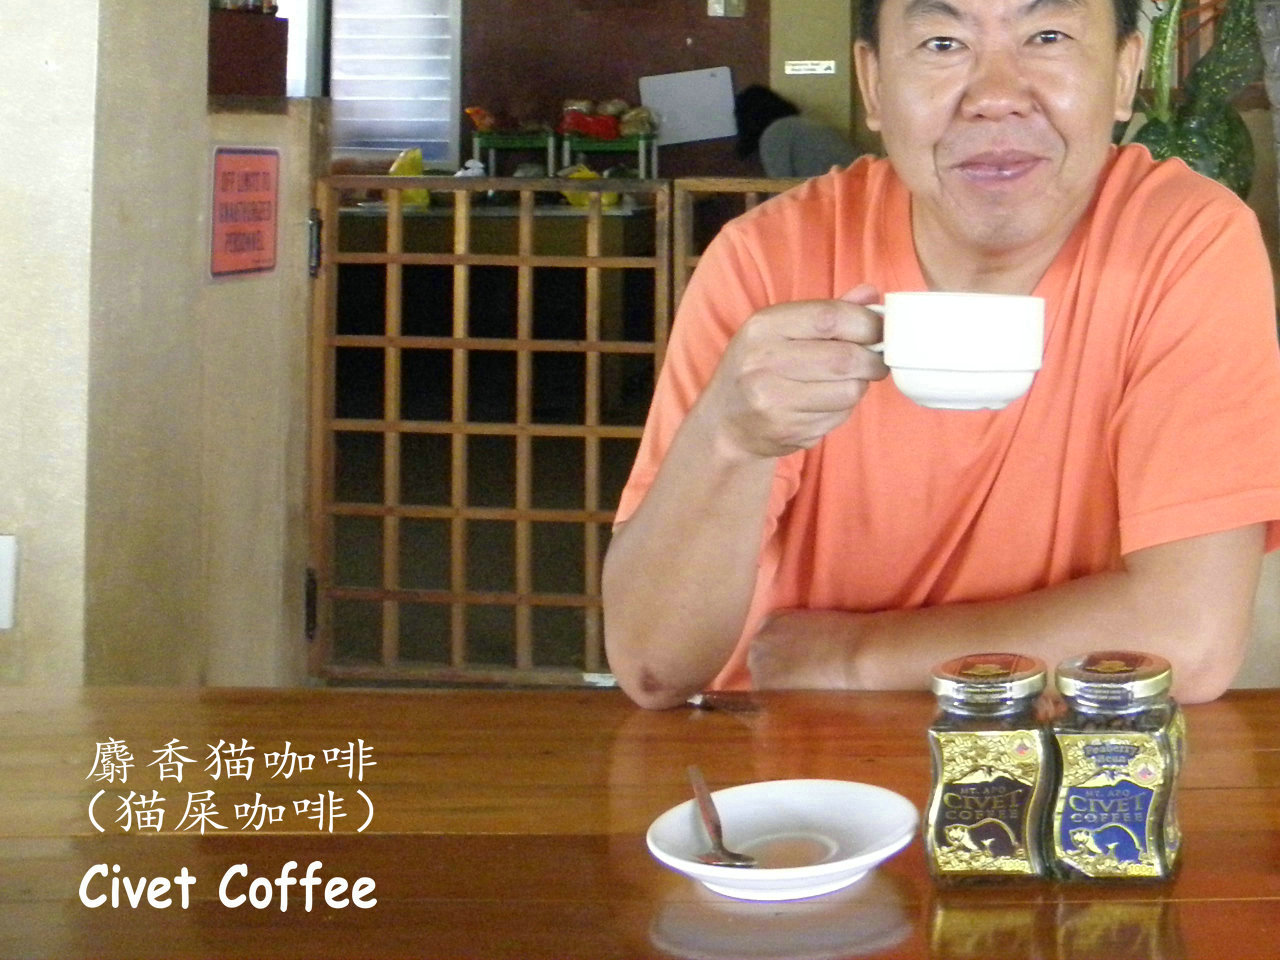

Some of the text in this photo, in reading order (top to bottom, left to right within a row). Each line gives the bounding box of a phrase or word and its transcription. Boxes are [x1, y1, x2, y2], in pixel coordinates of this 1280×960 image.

[943, 789, 1023, 809] CIVET
[1069, 791, 1147, 812] CIVET
[945, 810, 1018, 820] COFFEE
[1070, 813, 1144, 822] COFFEE
